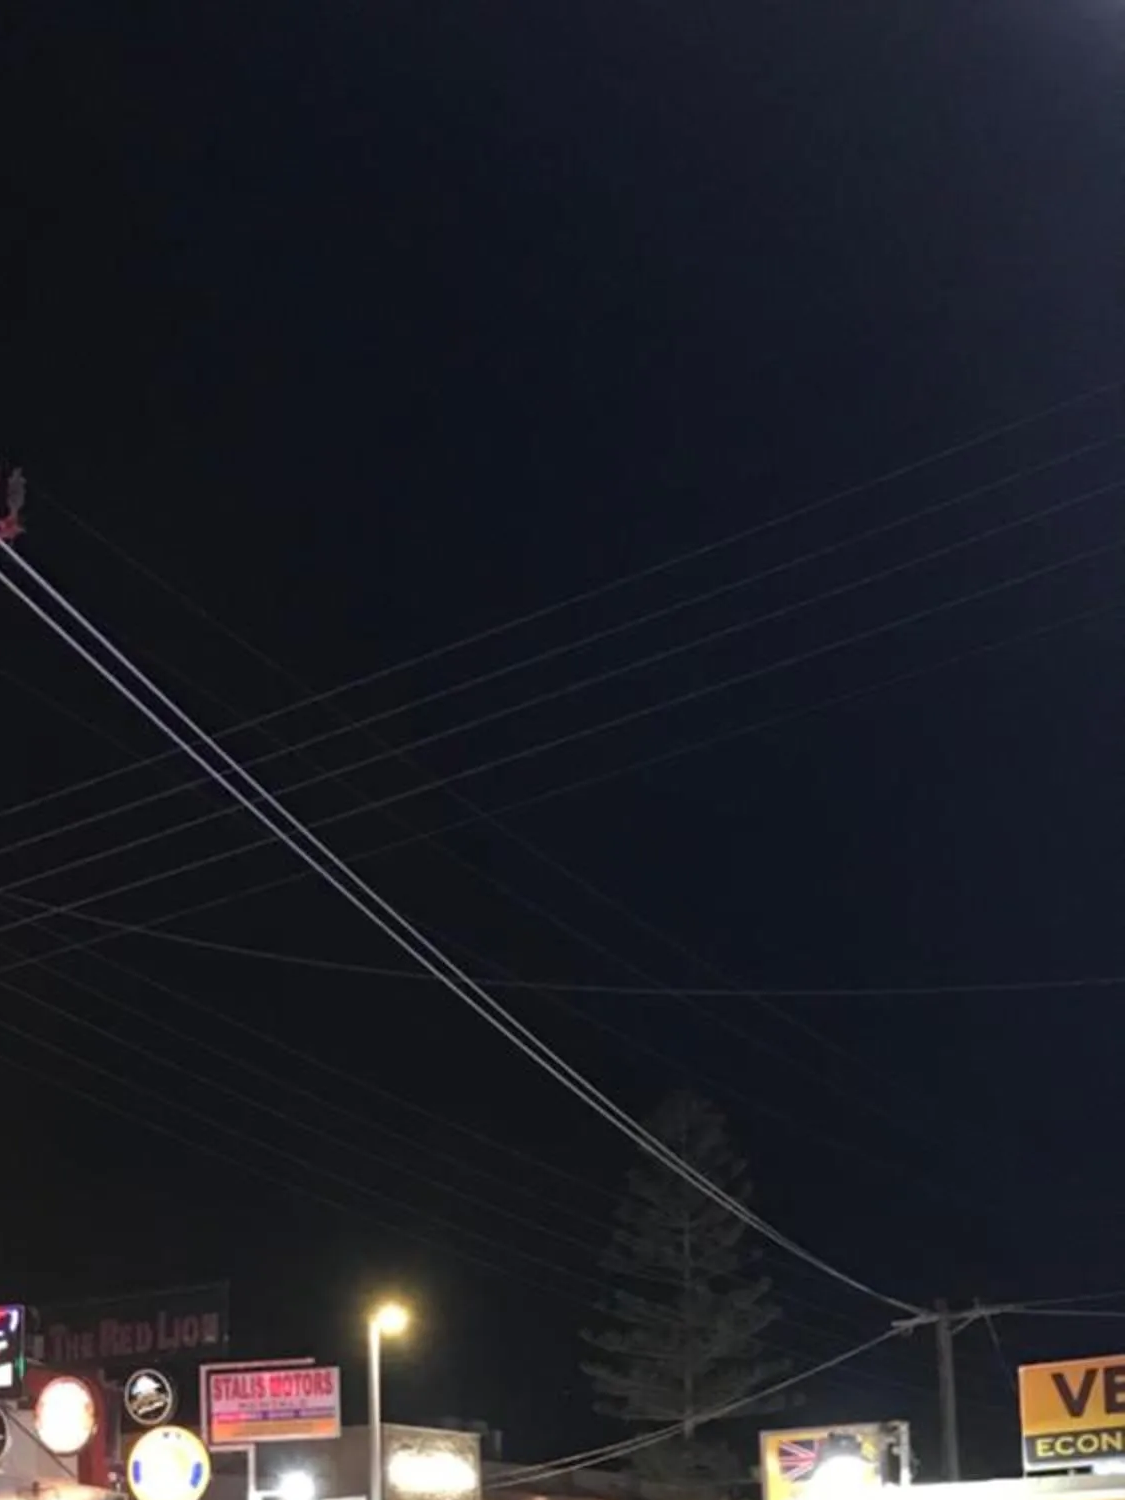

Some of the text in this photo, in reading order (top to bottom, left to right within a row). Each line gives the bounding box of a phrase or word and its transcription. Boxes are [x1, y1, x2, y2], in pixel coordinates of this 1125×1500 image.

[99, 1316, 155, 1357] RED
[156, 1309, 220, 1350] LION
[269, 1371, 333, 1397] MOTORS
